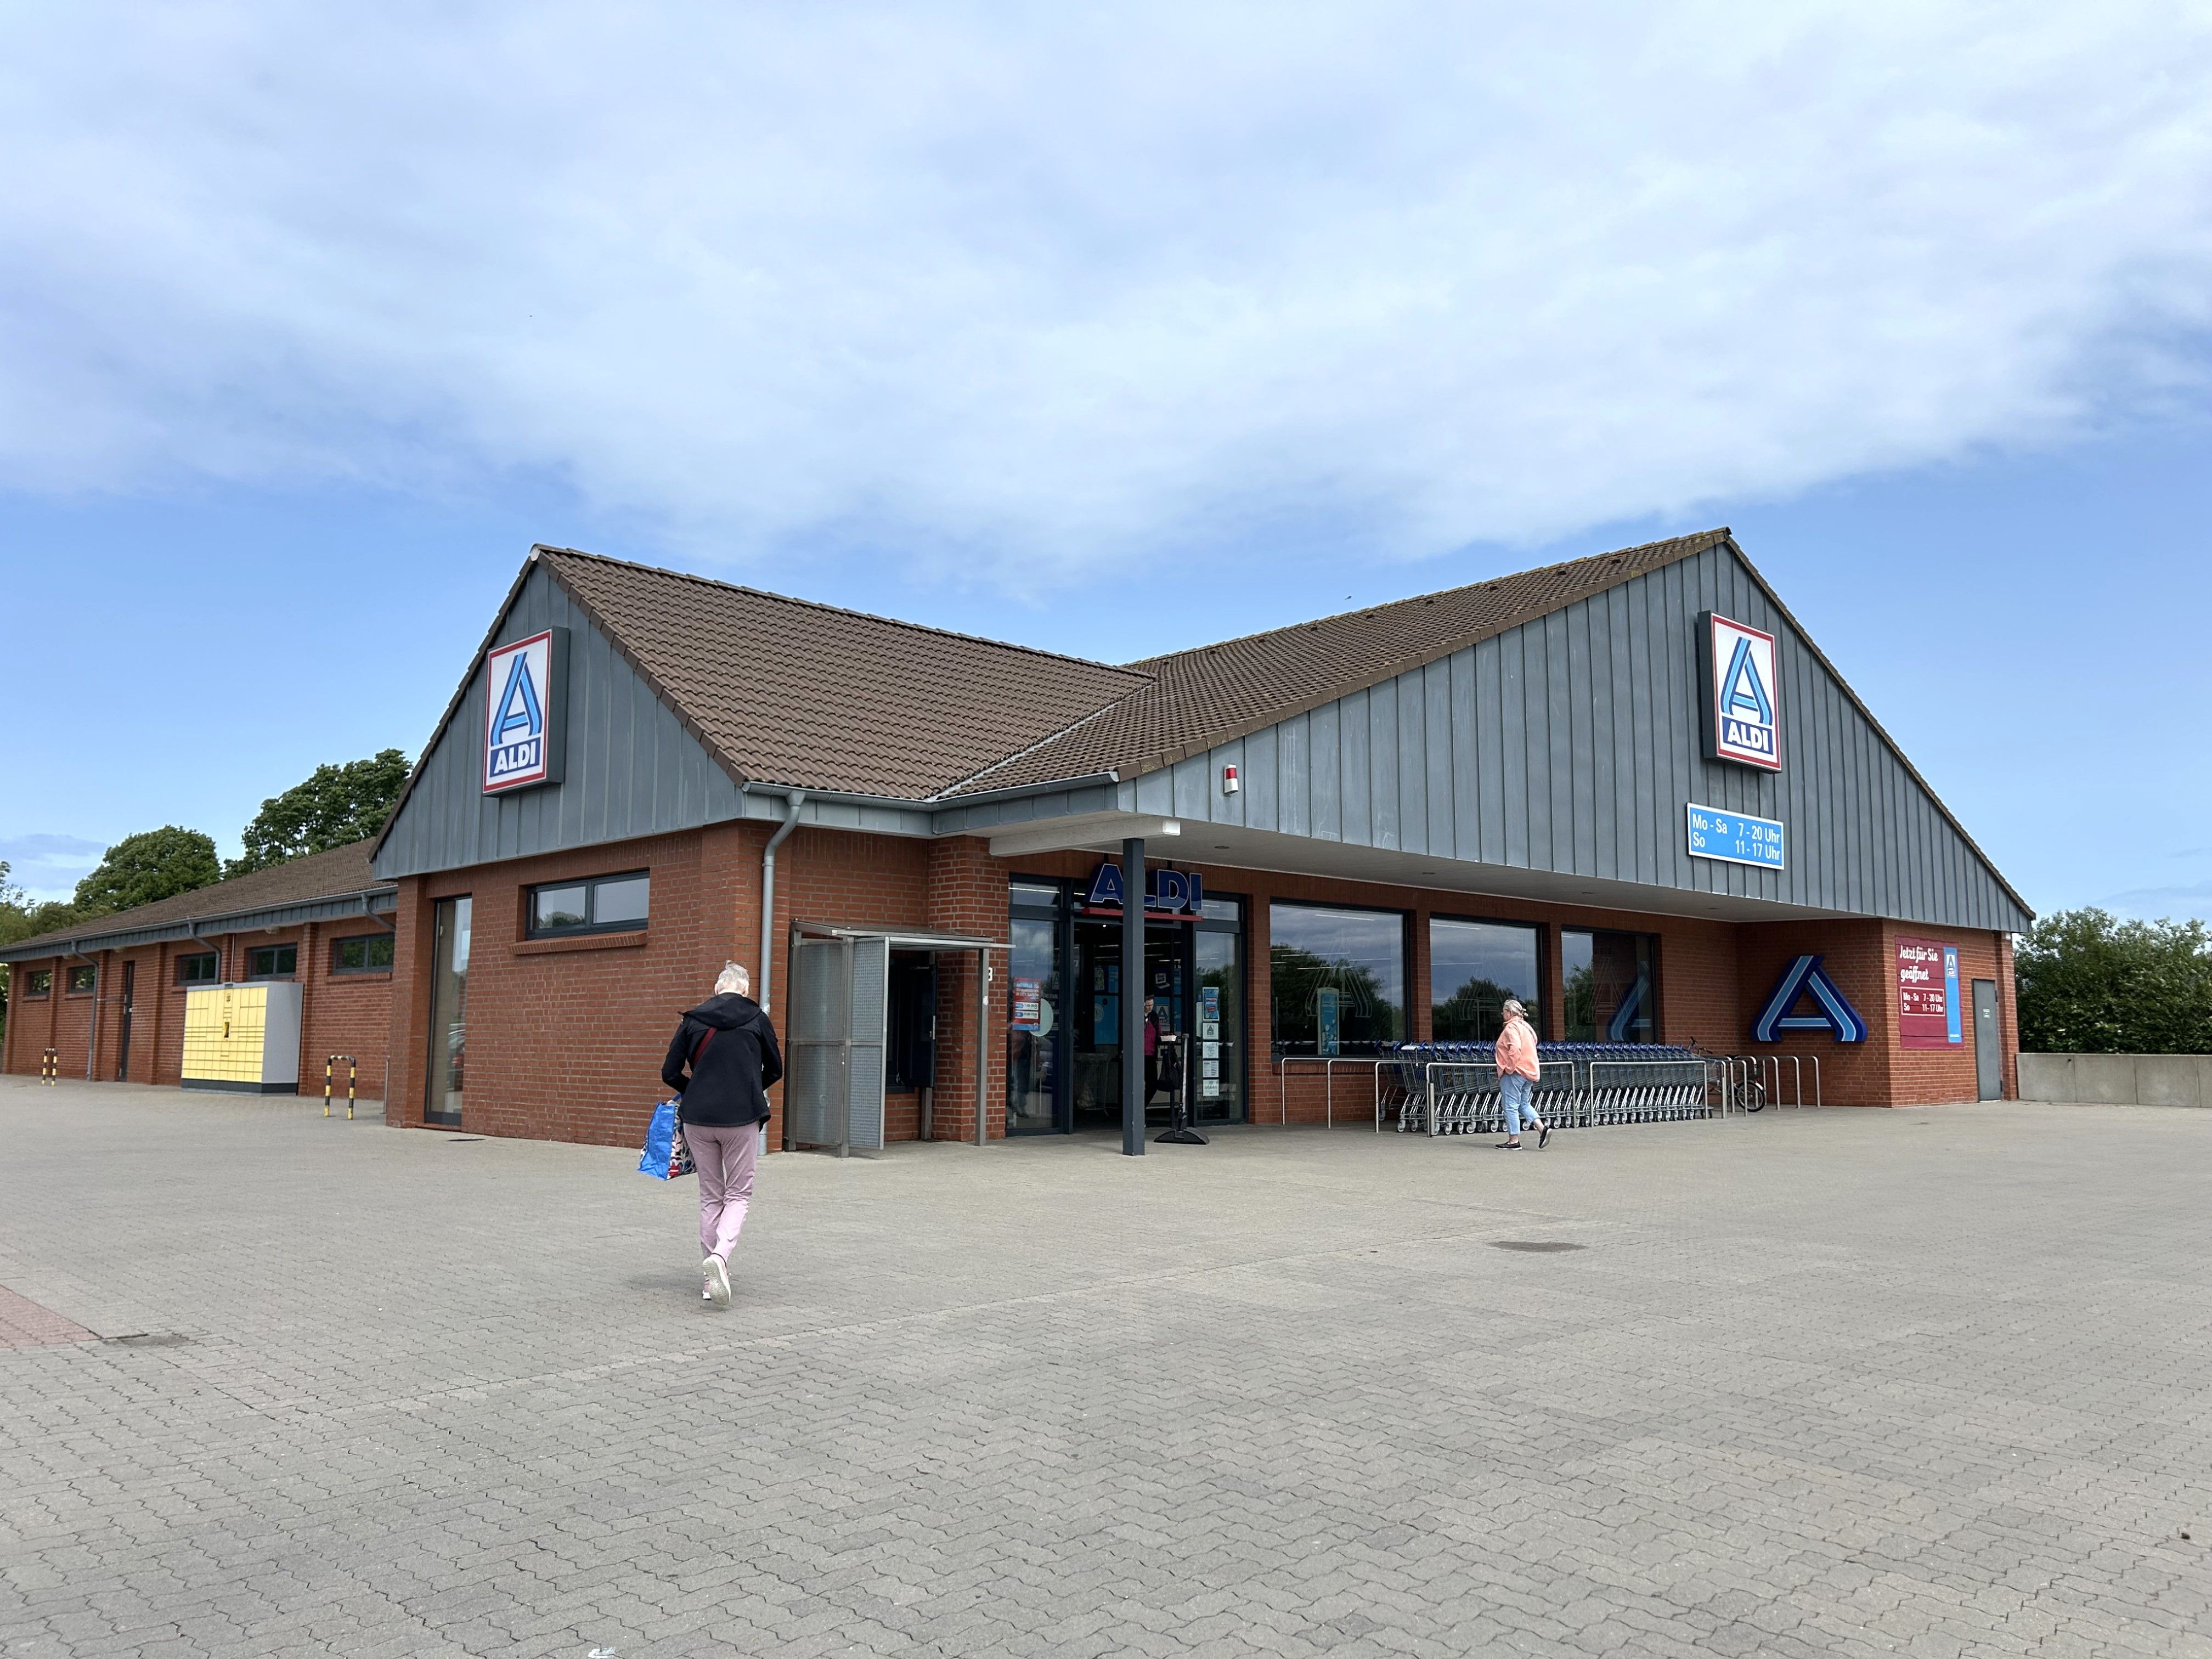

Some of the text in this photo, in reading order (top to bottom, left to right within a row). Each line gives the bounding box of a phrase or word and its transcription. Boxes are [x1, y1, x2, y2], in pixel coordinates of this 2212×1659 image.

[1727, 720, 1769, 752] ALDI
[494, 741, 537, 774] ALDI
[1692, 813, 1708, 831] Mo
[1716, 818, 1728, 834] Sa
[1738, 822, 1744, 837] 7
[1752, 825, 1763, 840] 20
[1765, 827, 1780, 844] Uhr
[1692, 831, 1706, 848] So
[1735, 839, 1745, 854] 11
[1752, 843, 1763, 857] 17
[1765, 845, 1780, 860] Uhr
[1090, 863, 1202, 911] ADI
[1899, 945, 1939, 963] Jetzt für Sie
[1900, 966, 1929, 983] geöffnet
[1903, 992, 1911, 1001] Mo
[1913, 992, 1919, 1001] Sa
[1922, 993, 1926, 1001] 7
[1903, 1002, 1910, 1011] So
[1922, 1003, 1927, 1012] 11
[1930, 1003, 1935, 1012] 17
